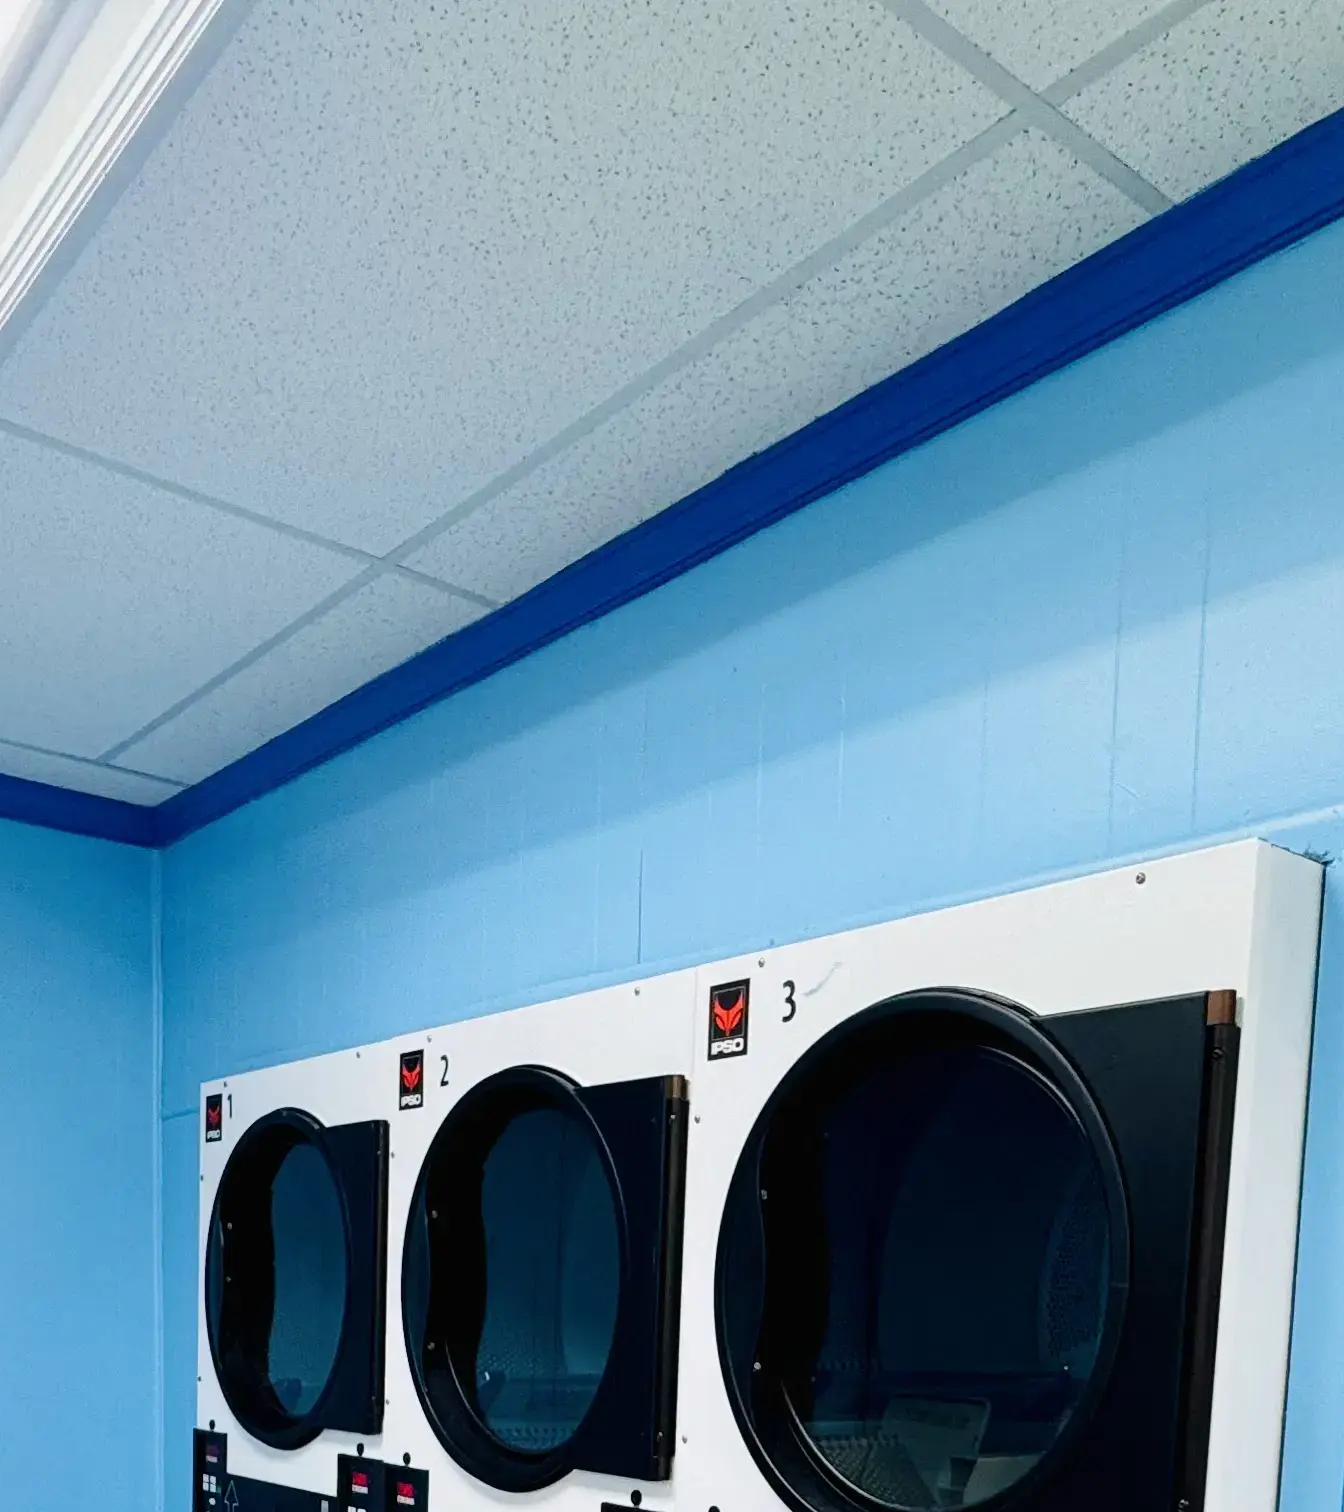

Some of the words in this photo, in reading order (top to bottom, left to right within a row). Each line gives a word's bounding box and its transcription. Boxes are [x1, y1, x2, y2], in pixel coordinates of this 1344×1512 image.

[782, 979, 796, 1023] 3
[710, 1037, 744, 1056] IPSO
[440, 1054, 449, 1087] 2
[227, 1093, 233, 1119] 1
